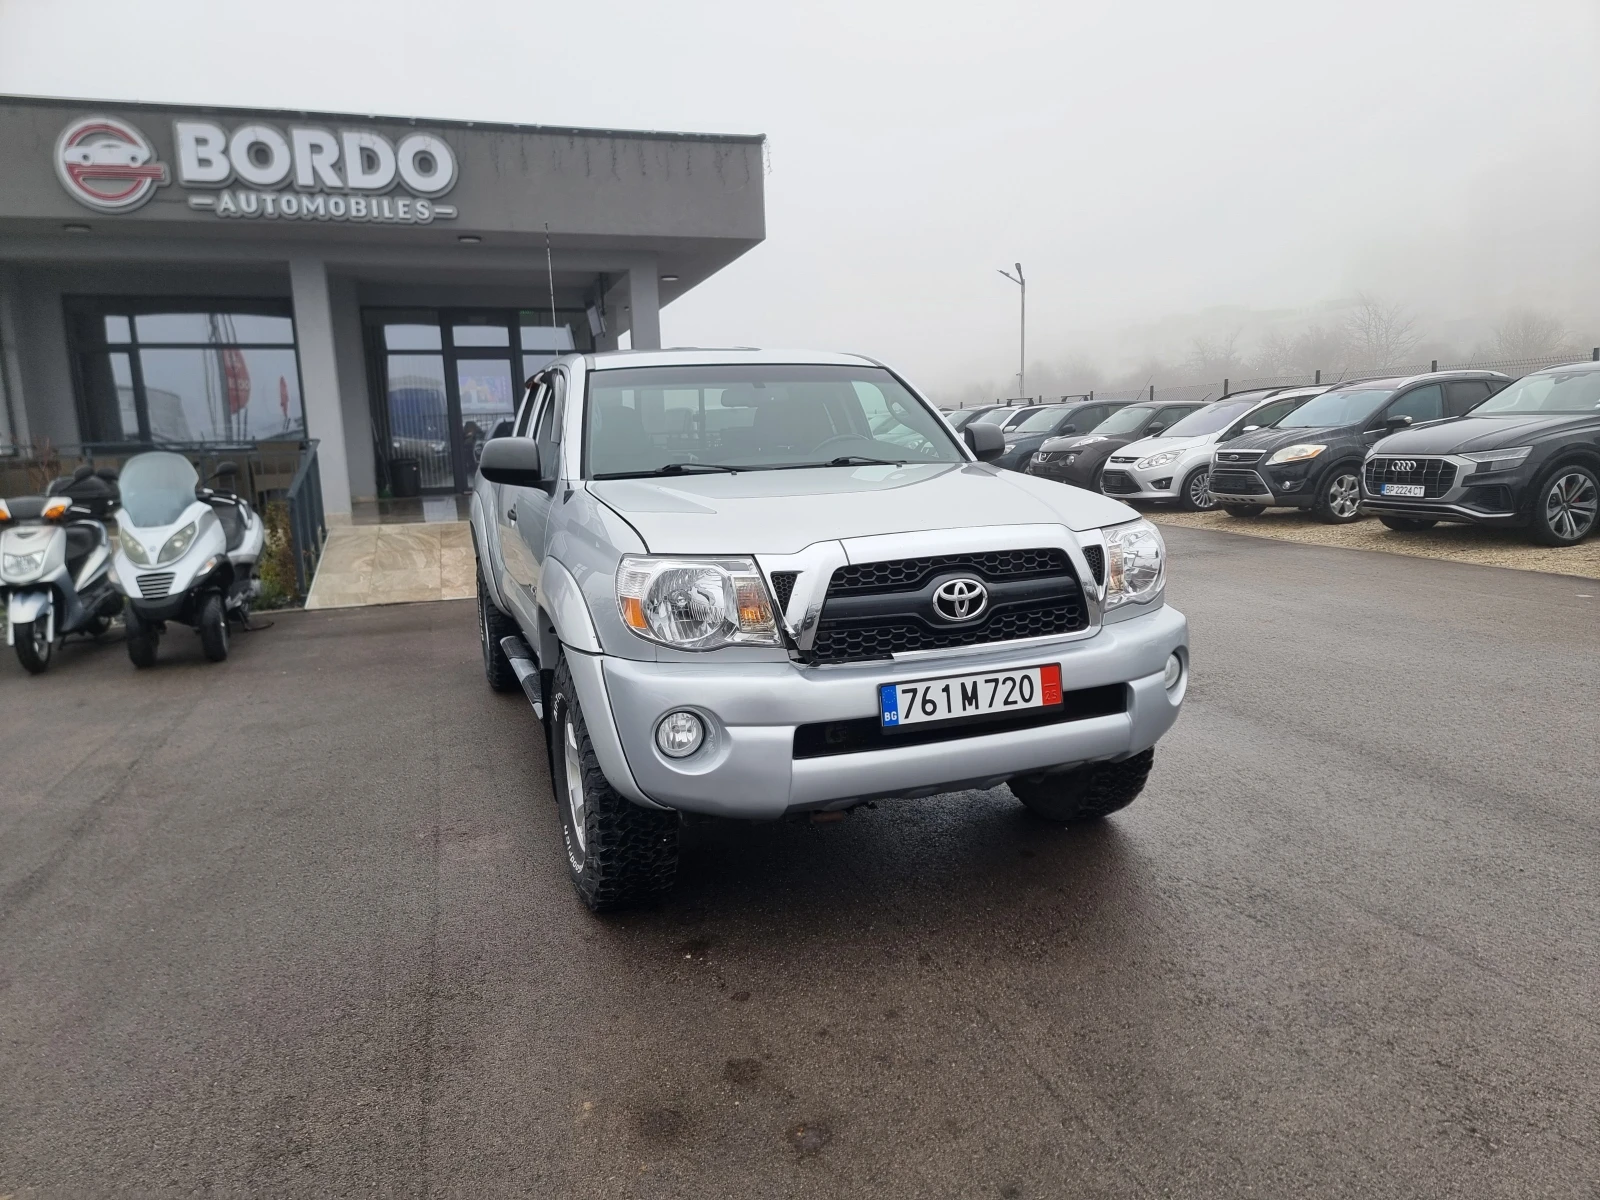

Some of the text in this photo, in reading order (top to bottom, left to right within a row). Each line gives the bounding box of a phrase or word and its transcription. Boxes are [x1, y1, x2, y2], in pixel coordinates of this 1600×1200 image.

[176, 122, 454, 192] BORDO
[218, 191, 431, 220] AUTOMOBILES
[1385, 485, 1395, 494] BP
[1395, 486, 1412, 495] 2224
[1413, 486, 1424, 495] CT
[884, 711, 898, 721] BG
